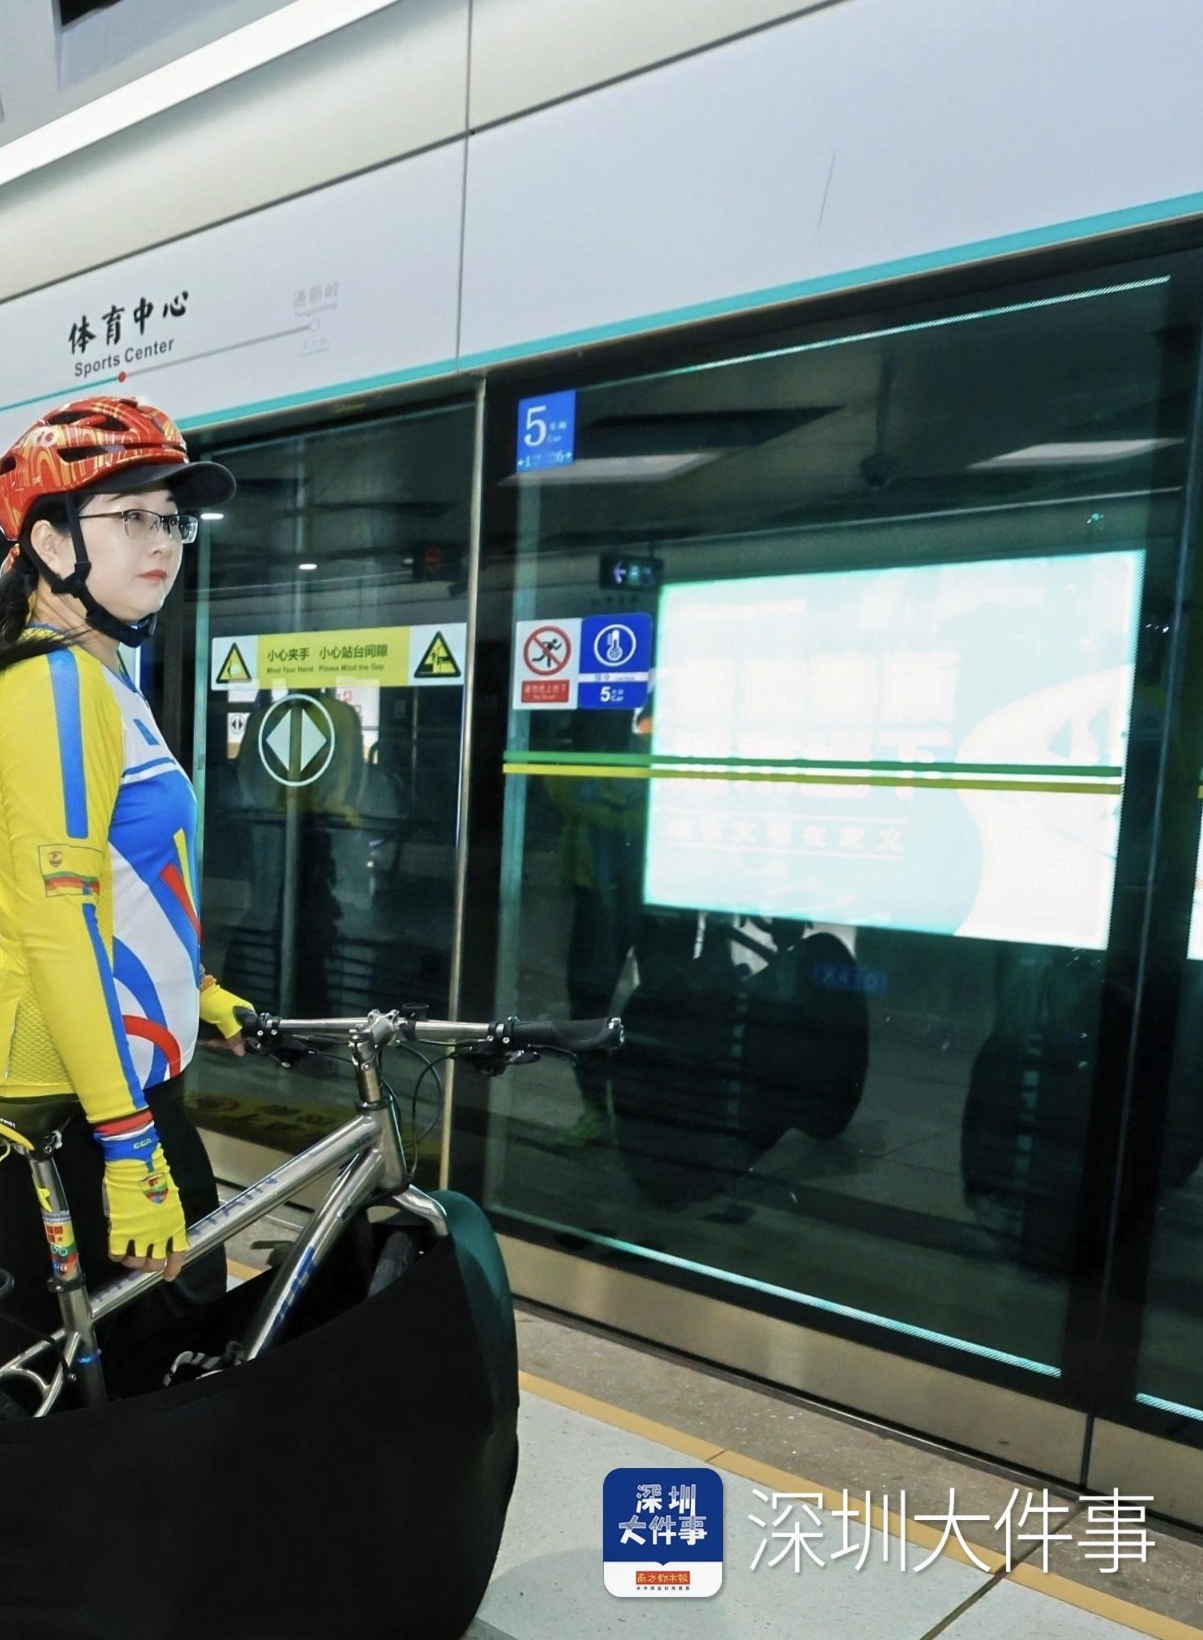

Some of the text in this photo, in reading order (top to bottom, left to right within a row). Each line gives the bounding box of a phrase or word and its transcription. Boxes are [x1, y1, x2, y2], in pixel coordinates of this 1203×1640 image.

[69, 290, 189, 354] 体育中心
[74, 339, 175, 378] Sports Center
[523, 404, 547, 447] 5
[267, 643, 389, 662] 小心夹手 小心站台间隙
[600, 686, 611, 702] 5
